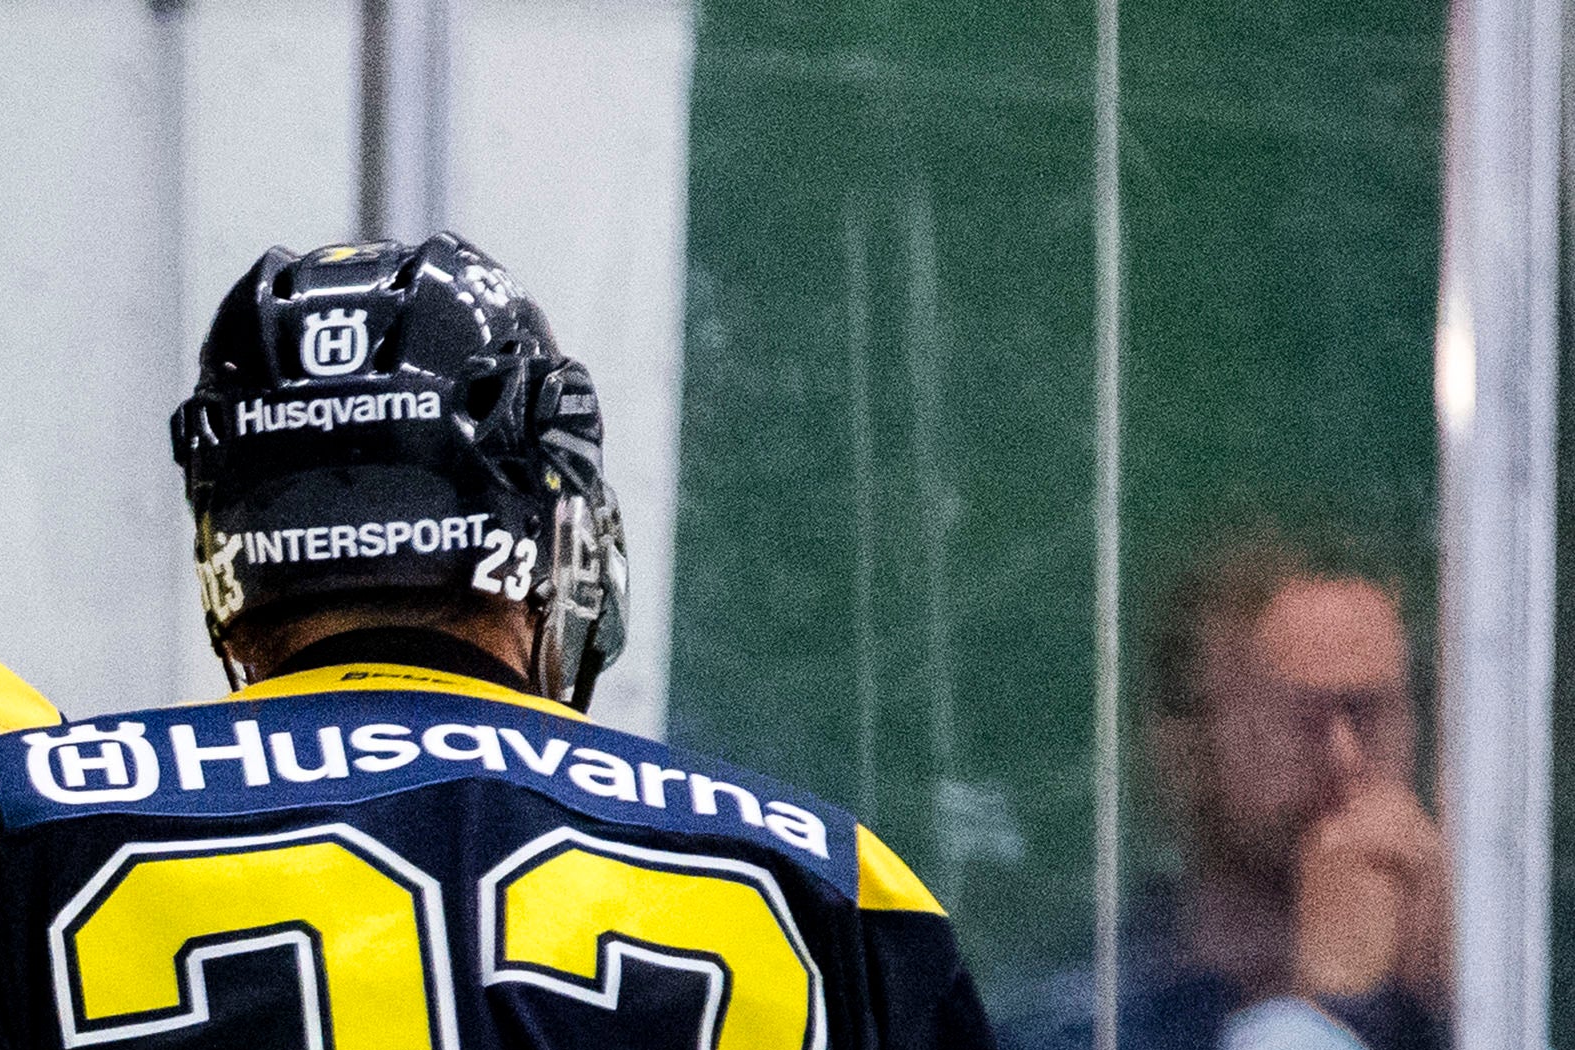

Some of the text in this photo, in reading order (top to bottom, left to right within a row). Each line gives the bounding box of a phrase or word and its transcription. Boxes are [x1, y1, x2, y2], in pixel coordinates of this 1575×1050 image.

[236, 389, 441, 437] Husqvarna
[244, 512, 490, 565] INTERSPORT
[472, 528, 537, 602] 23
[180, 717, 829, 860] Husqvarna
